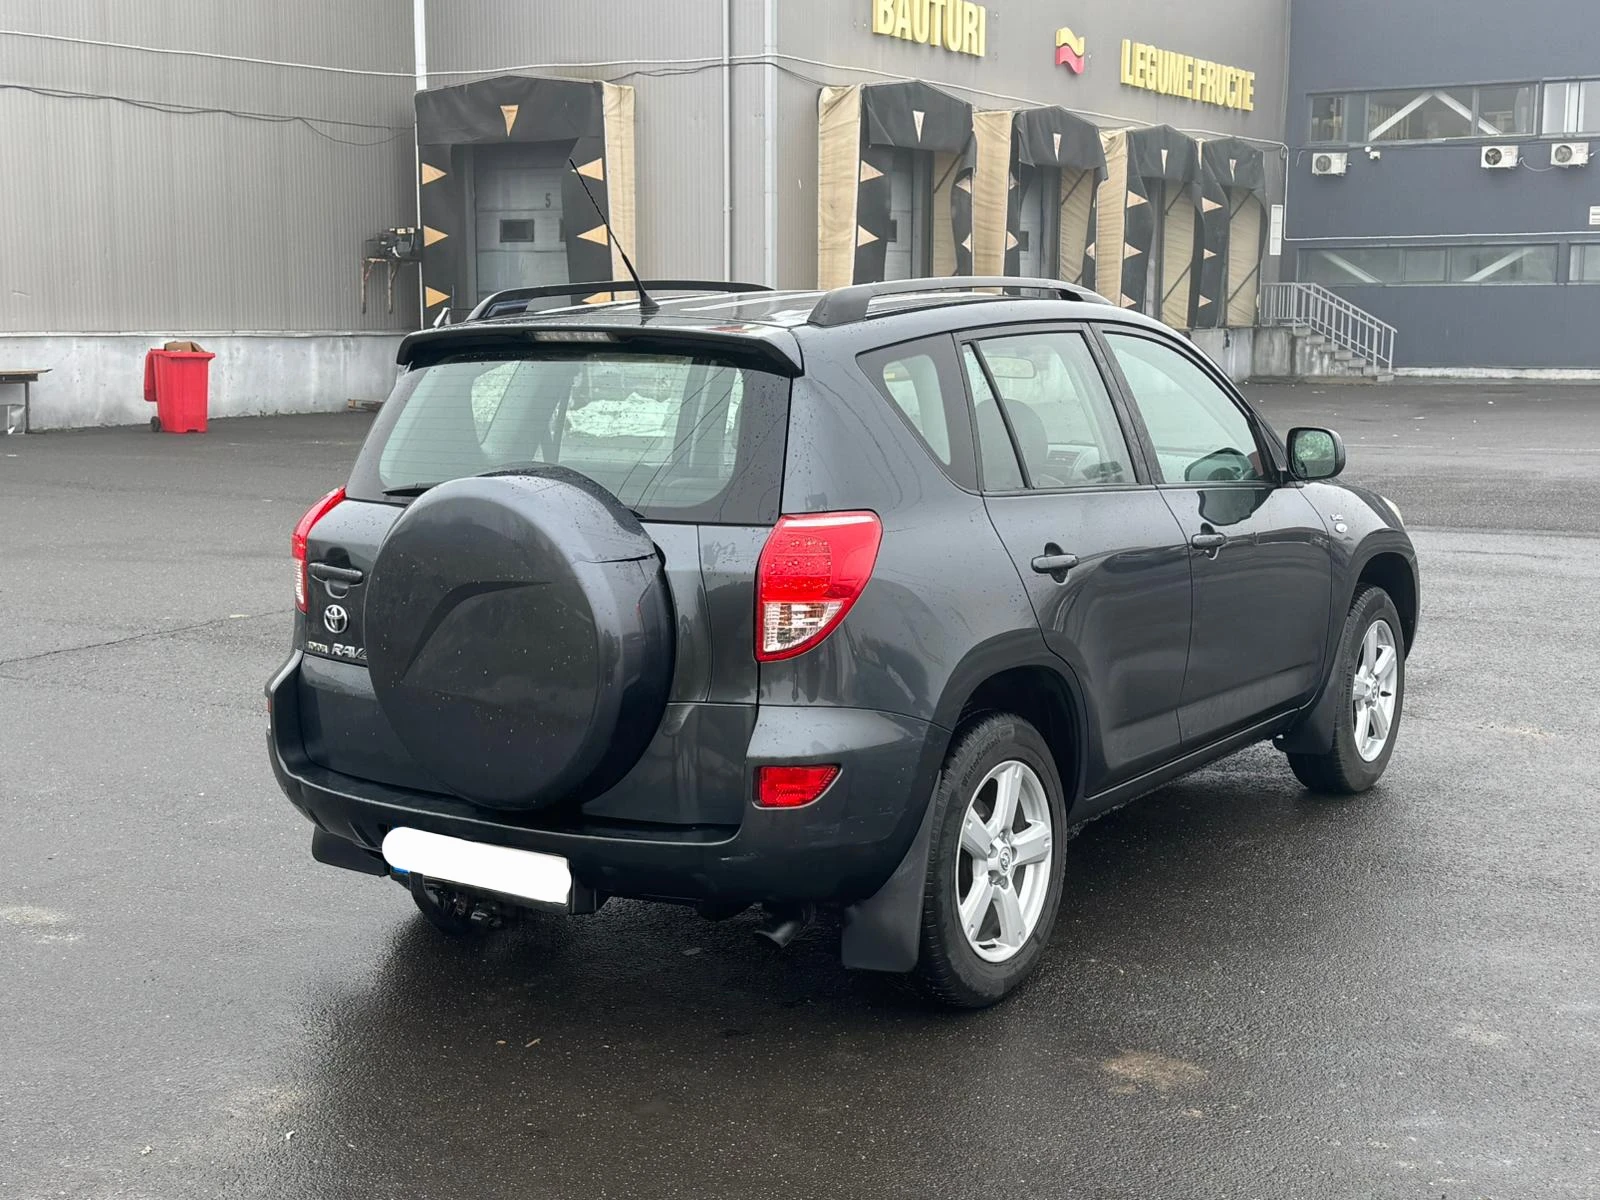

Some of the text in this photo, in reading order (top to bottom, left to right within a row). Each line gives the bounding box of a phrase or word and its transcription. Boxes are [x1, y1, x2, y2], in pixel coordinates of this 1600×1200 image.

[872, 0, 986, 57] BAUTURI
[1120, 39, 1194, 99] LEGUME
[545, 192, 551, 208] 5
